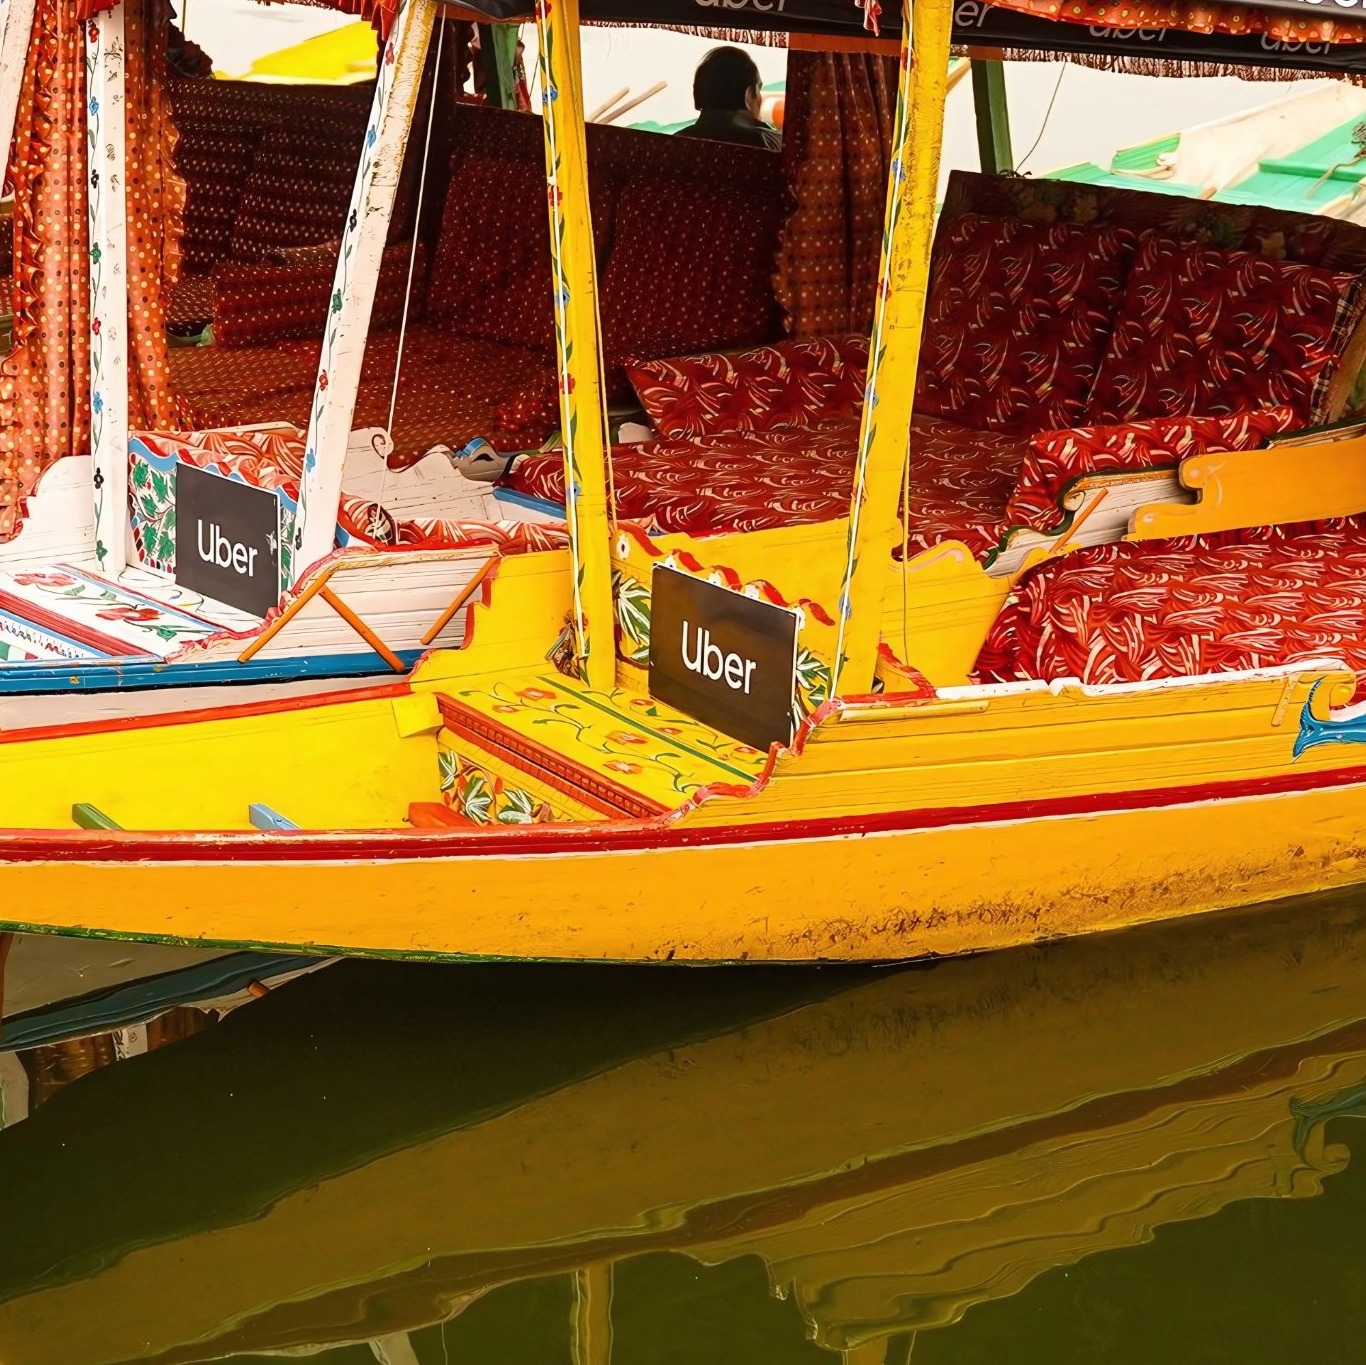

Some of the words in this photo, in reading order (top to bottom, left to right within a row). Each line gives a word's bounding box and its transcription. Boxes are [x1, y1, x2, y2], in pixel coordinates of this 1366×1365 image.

[954, 0, 995, 29] er
[197, 519, 258, 577] Uber
[681, 620, 757, 694] Uber
